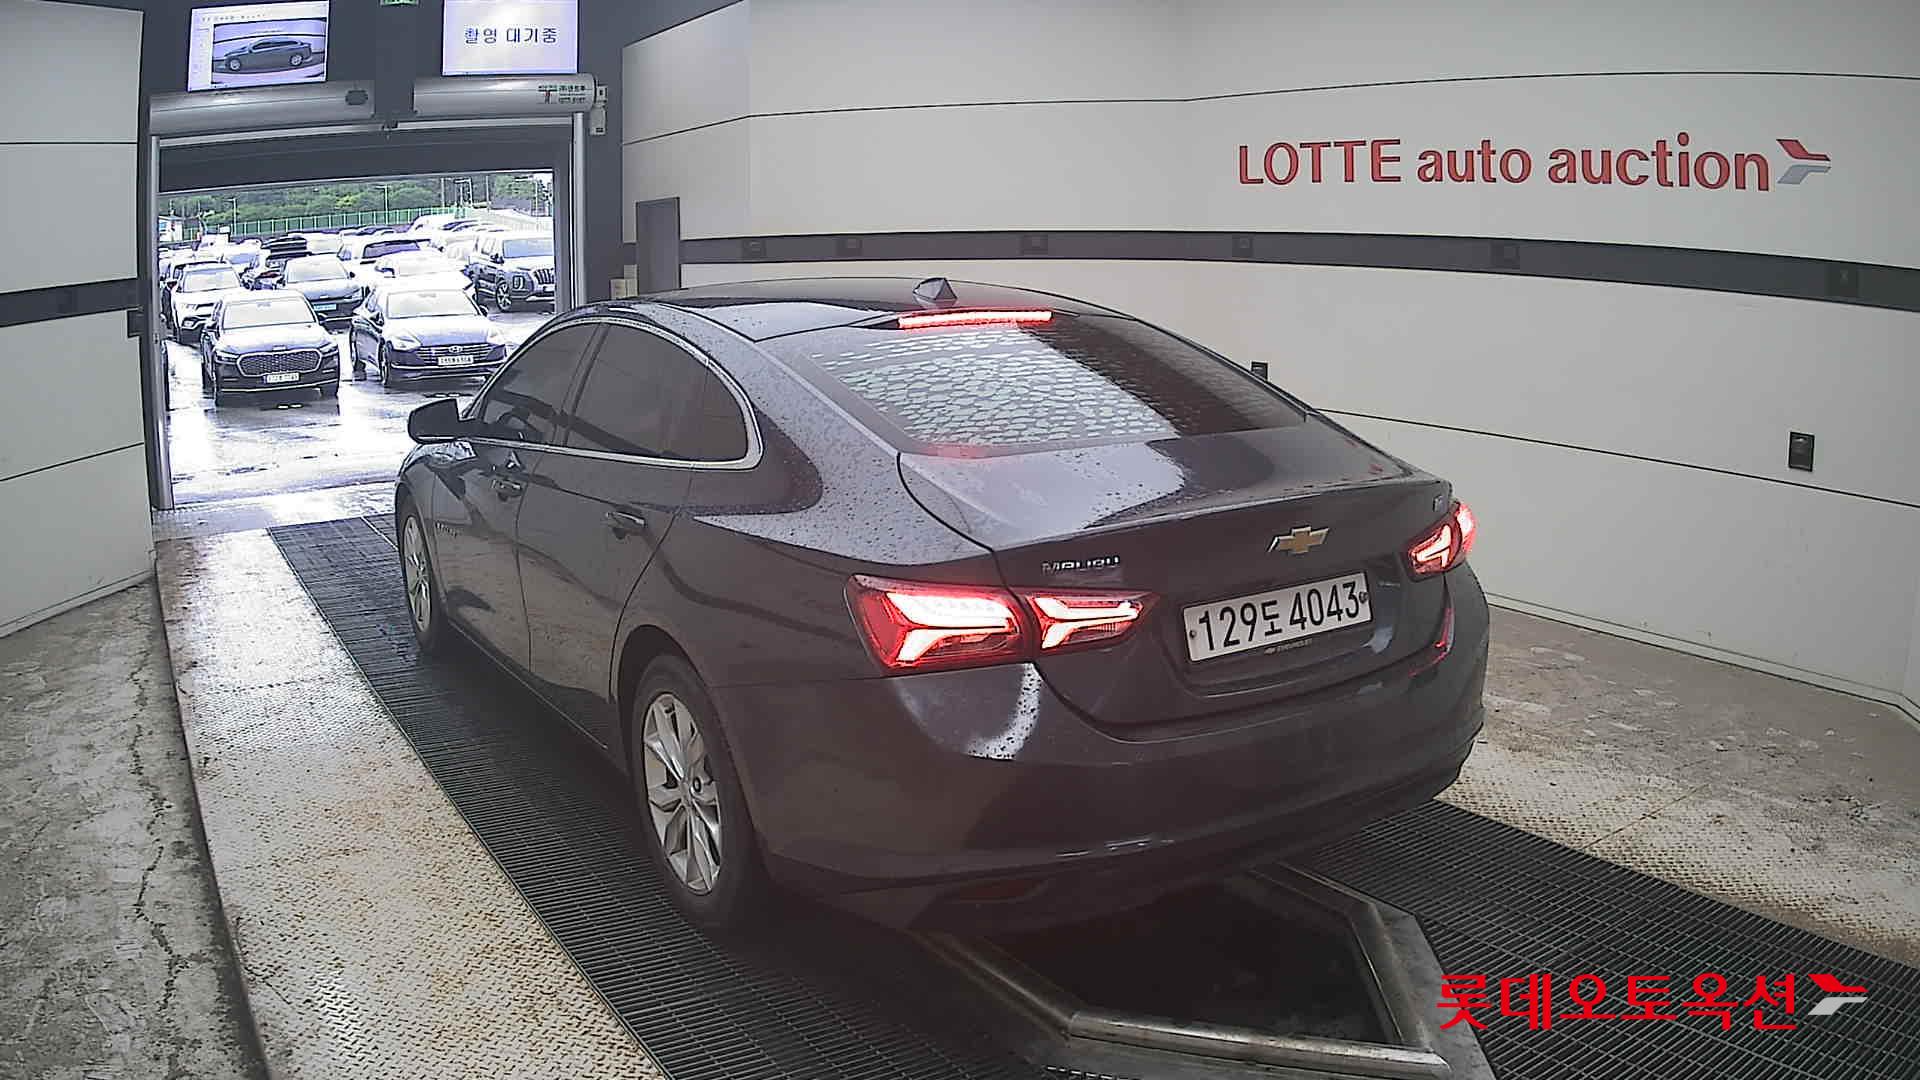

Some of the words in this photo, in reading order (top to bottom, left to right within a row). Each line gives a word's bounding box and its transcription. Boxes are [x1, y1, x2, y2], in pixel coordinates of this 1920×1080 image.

[505, 27, 557, 44] 대기중
[1239, 138, 1402, 186] LOTTE
[1417, 138, 1532, 184] auto
[1548, 131, 1770, 192] auction
[1289, 580, 1360, 631] 4043
